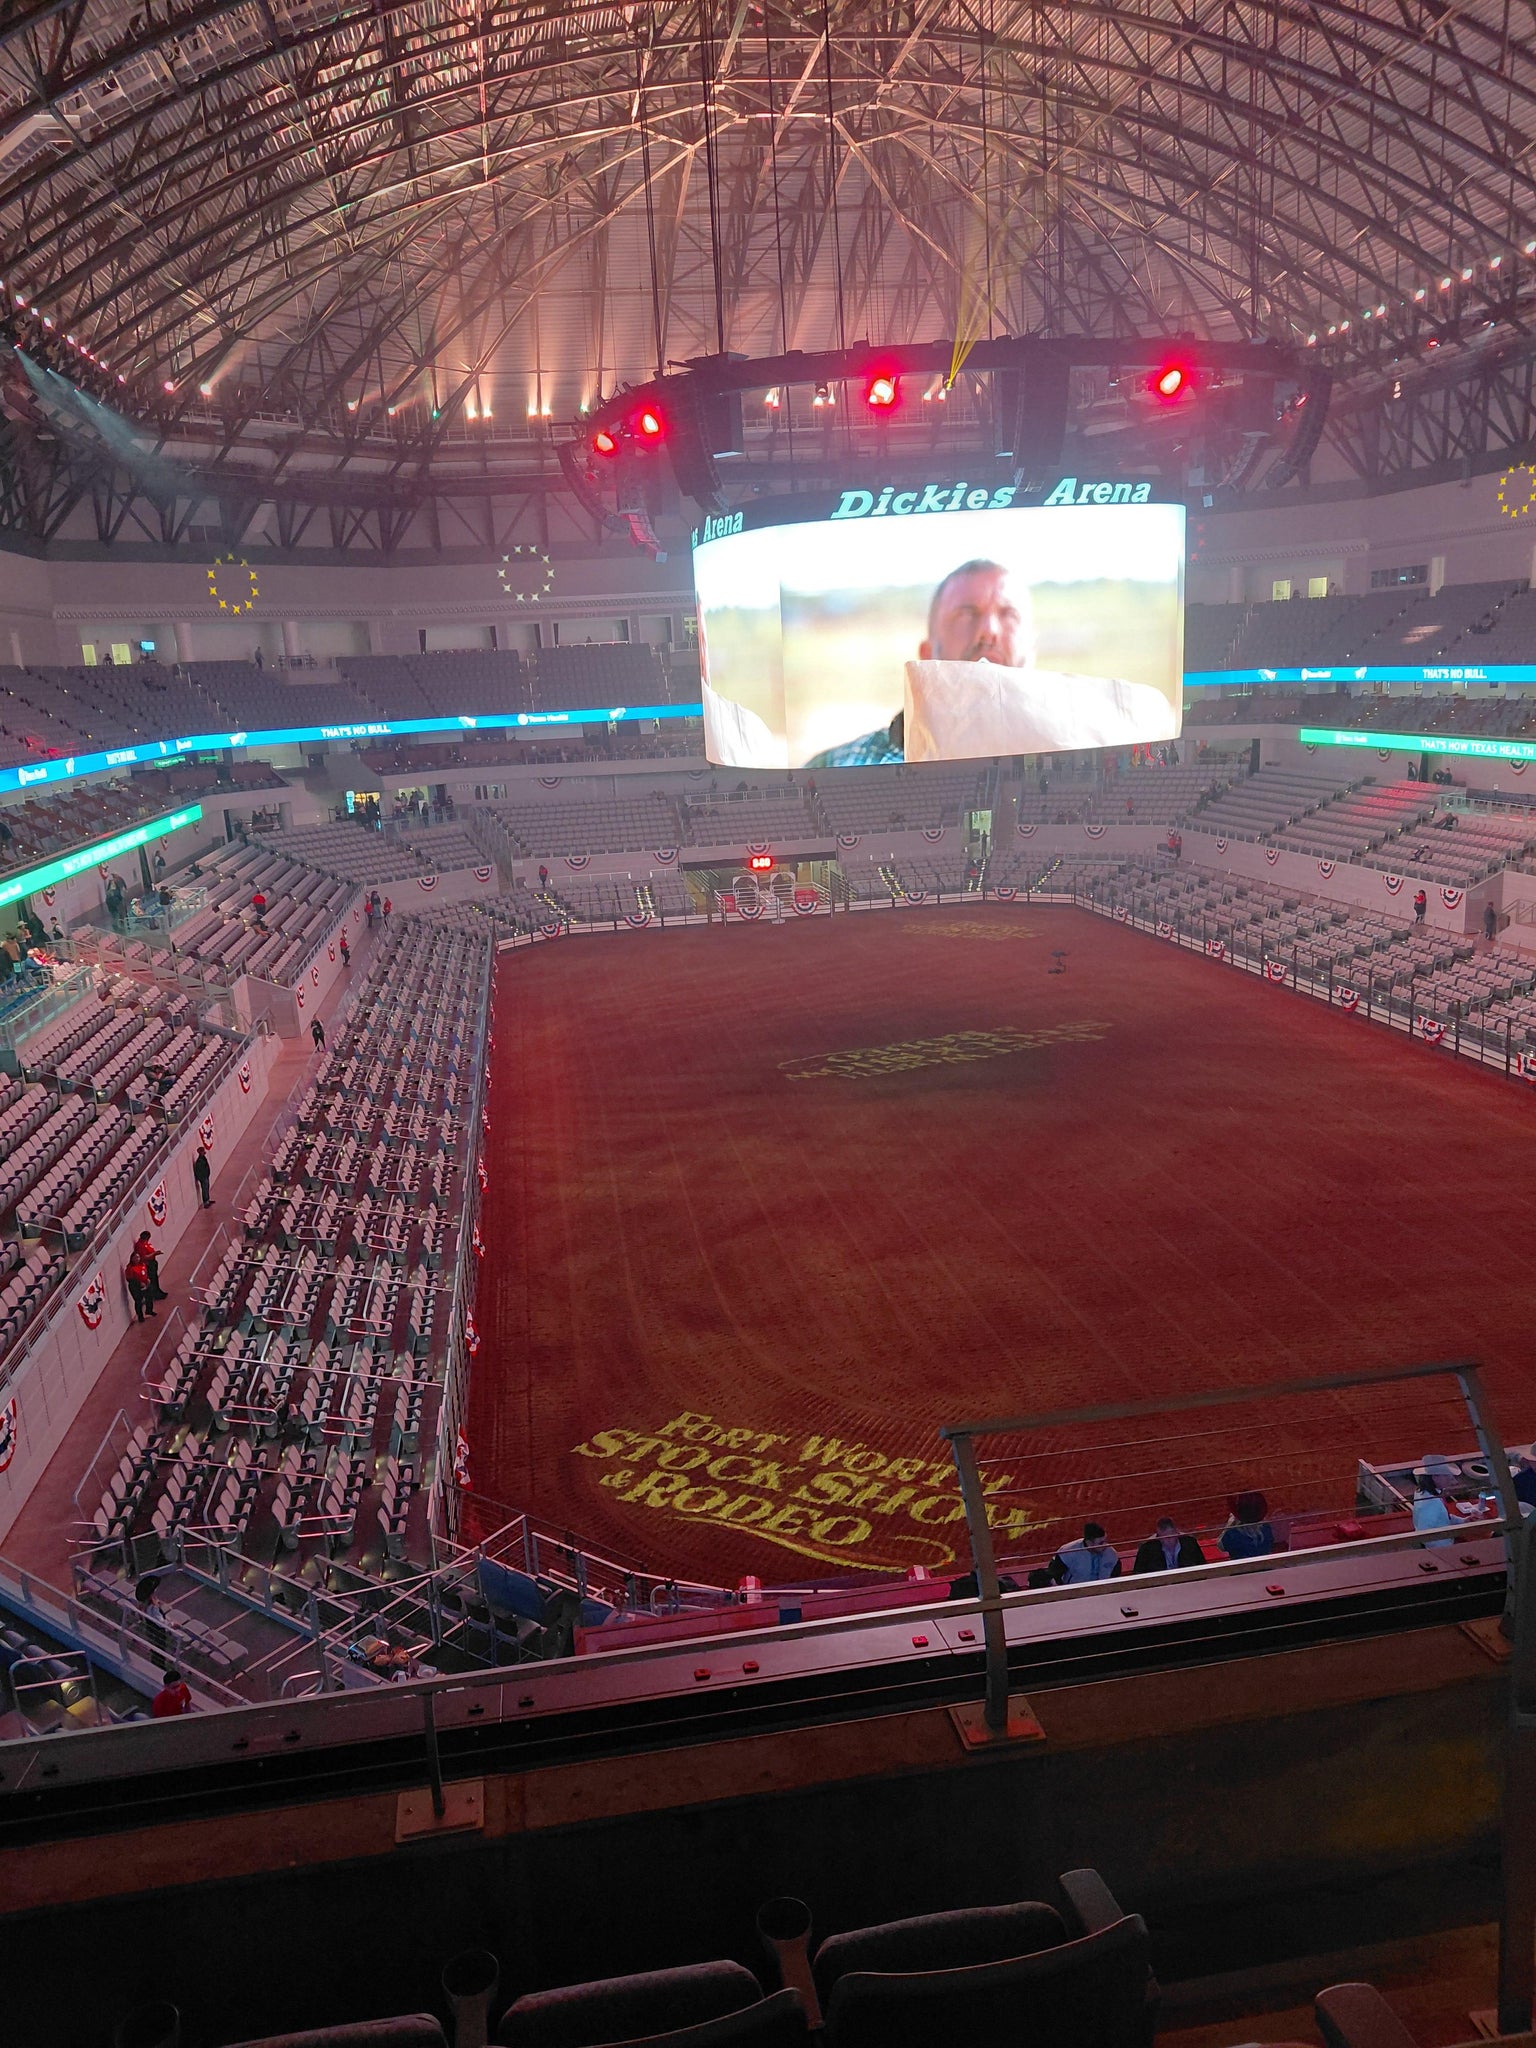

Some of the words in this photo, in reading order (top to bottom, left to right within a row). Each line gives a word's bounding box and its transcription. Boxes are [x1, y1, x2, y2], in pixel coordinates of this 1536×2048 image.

[830, 482, 1017, 519] Dickies
[1043, 478, 1151, 506] Arena
[703, 511, 743, 543] Arena
[1422, 668, 1449, 679] THAT'S
[1450, 668, 1463, 679] NO
[352, 725, 367, 736] NO
[1420, 739, 1447, 750] THAT'S
[1448, 741, 1468, 752] HOW
[1470, 743, 1497, 754] TEXAS
[1499, 745, 1535, 756] HEALTH
[656, 1411, 791, 1453] FORT
[571, 1428, 806, 1491] STOCK
[616, 1470, 873, 1545] RODEO
